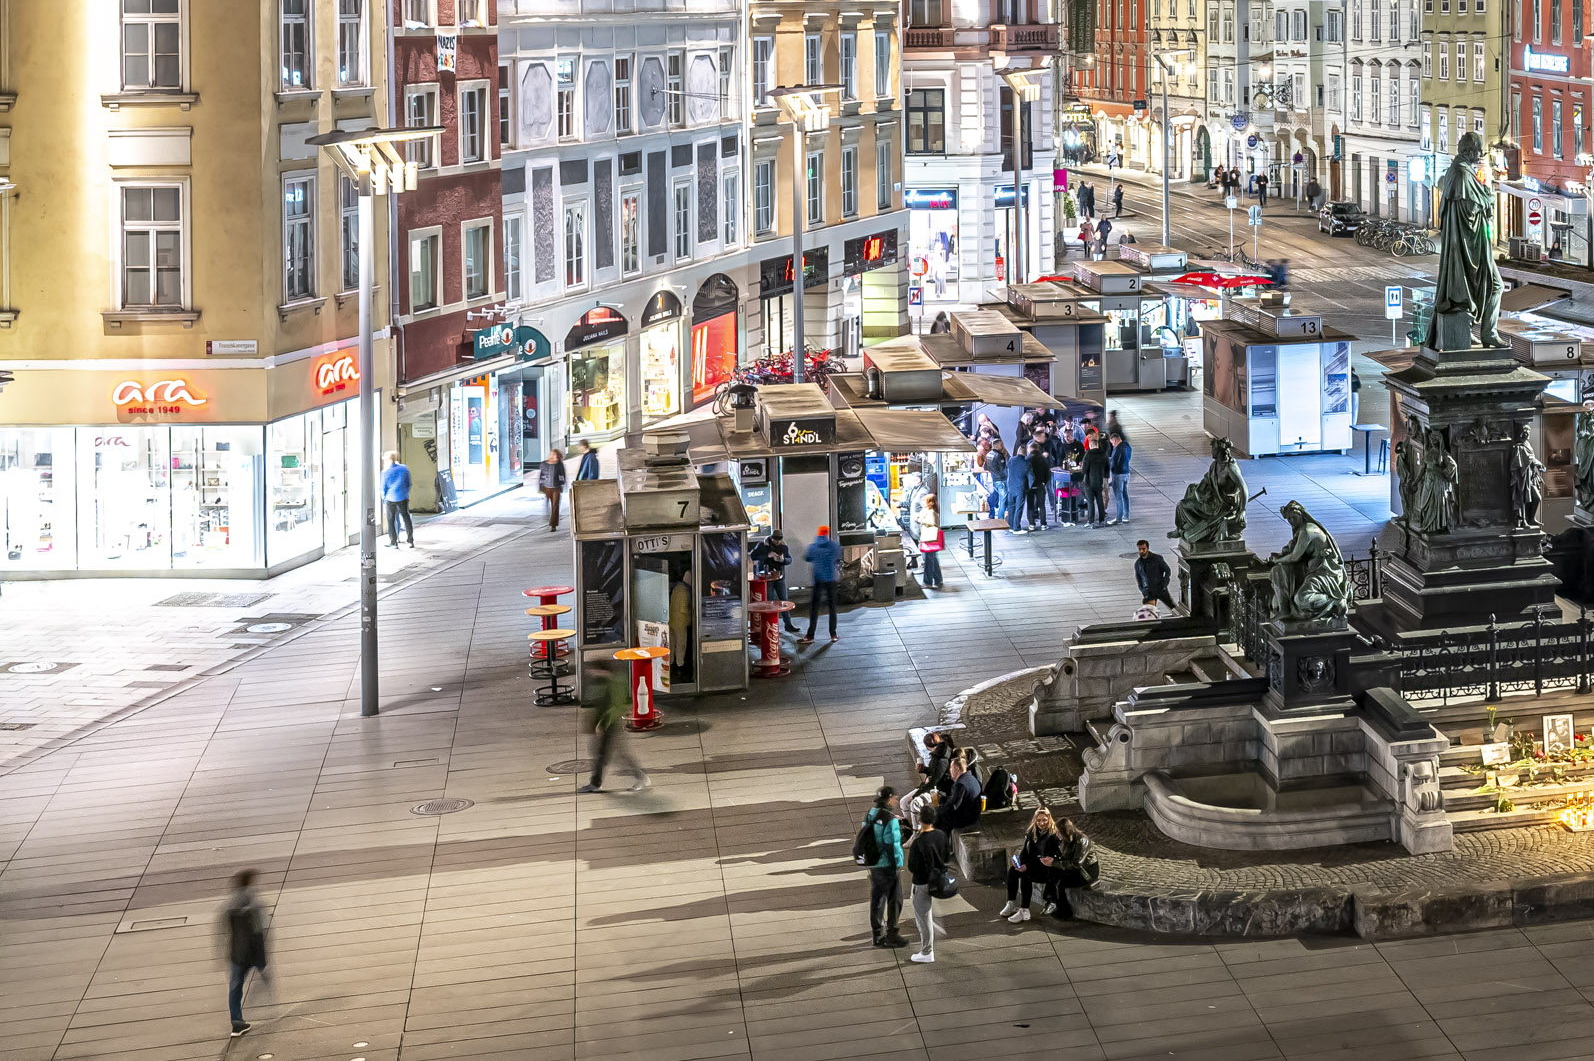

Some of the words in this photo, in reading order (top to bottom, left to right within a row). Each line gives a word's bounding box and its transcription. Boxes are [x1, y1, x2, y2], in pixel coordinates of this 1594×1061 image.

[1062, 111, 1088, 122] OTEL
[1177, 257, 1184, 267] 1
[1129, 279, 1136, 289] 2
[1064, 305, 1072, 316] 3
[598, 329, 609, 337] NAILS
[1300, 321, 1317, 334] 13
[1006, 341, 1015, 352] 4
[1566, 346, 1575, 359] 8
[318, 356, 361, 389] ara
[113, 379, 208, 405] ara
[128, 406, 154, 414] since
[158, 406, 181, 414] 1949
[94, 436, 131, 447] ara
[677, 500, 690, 518] 7
